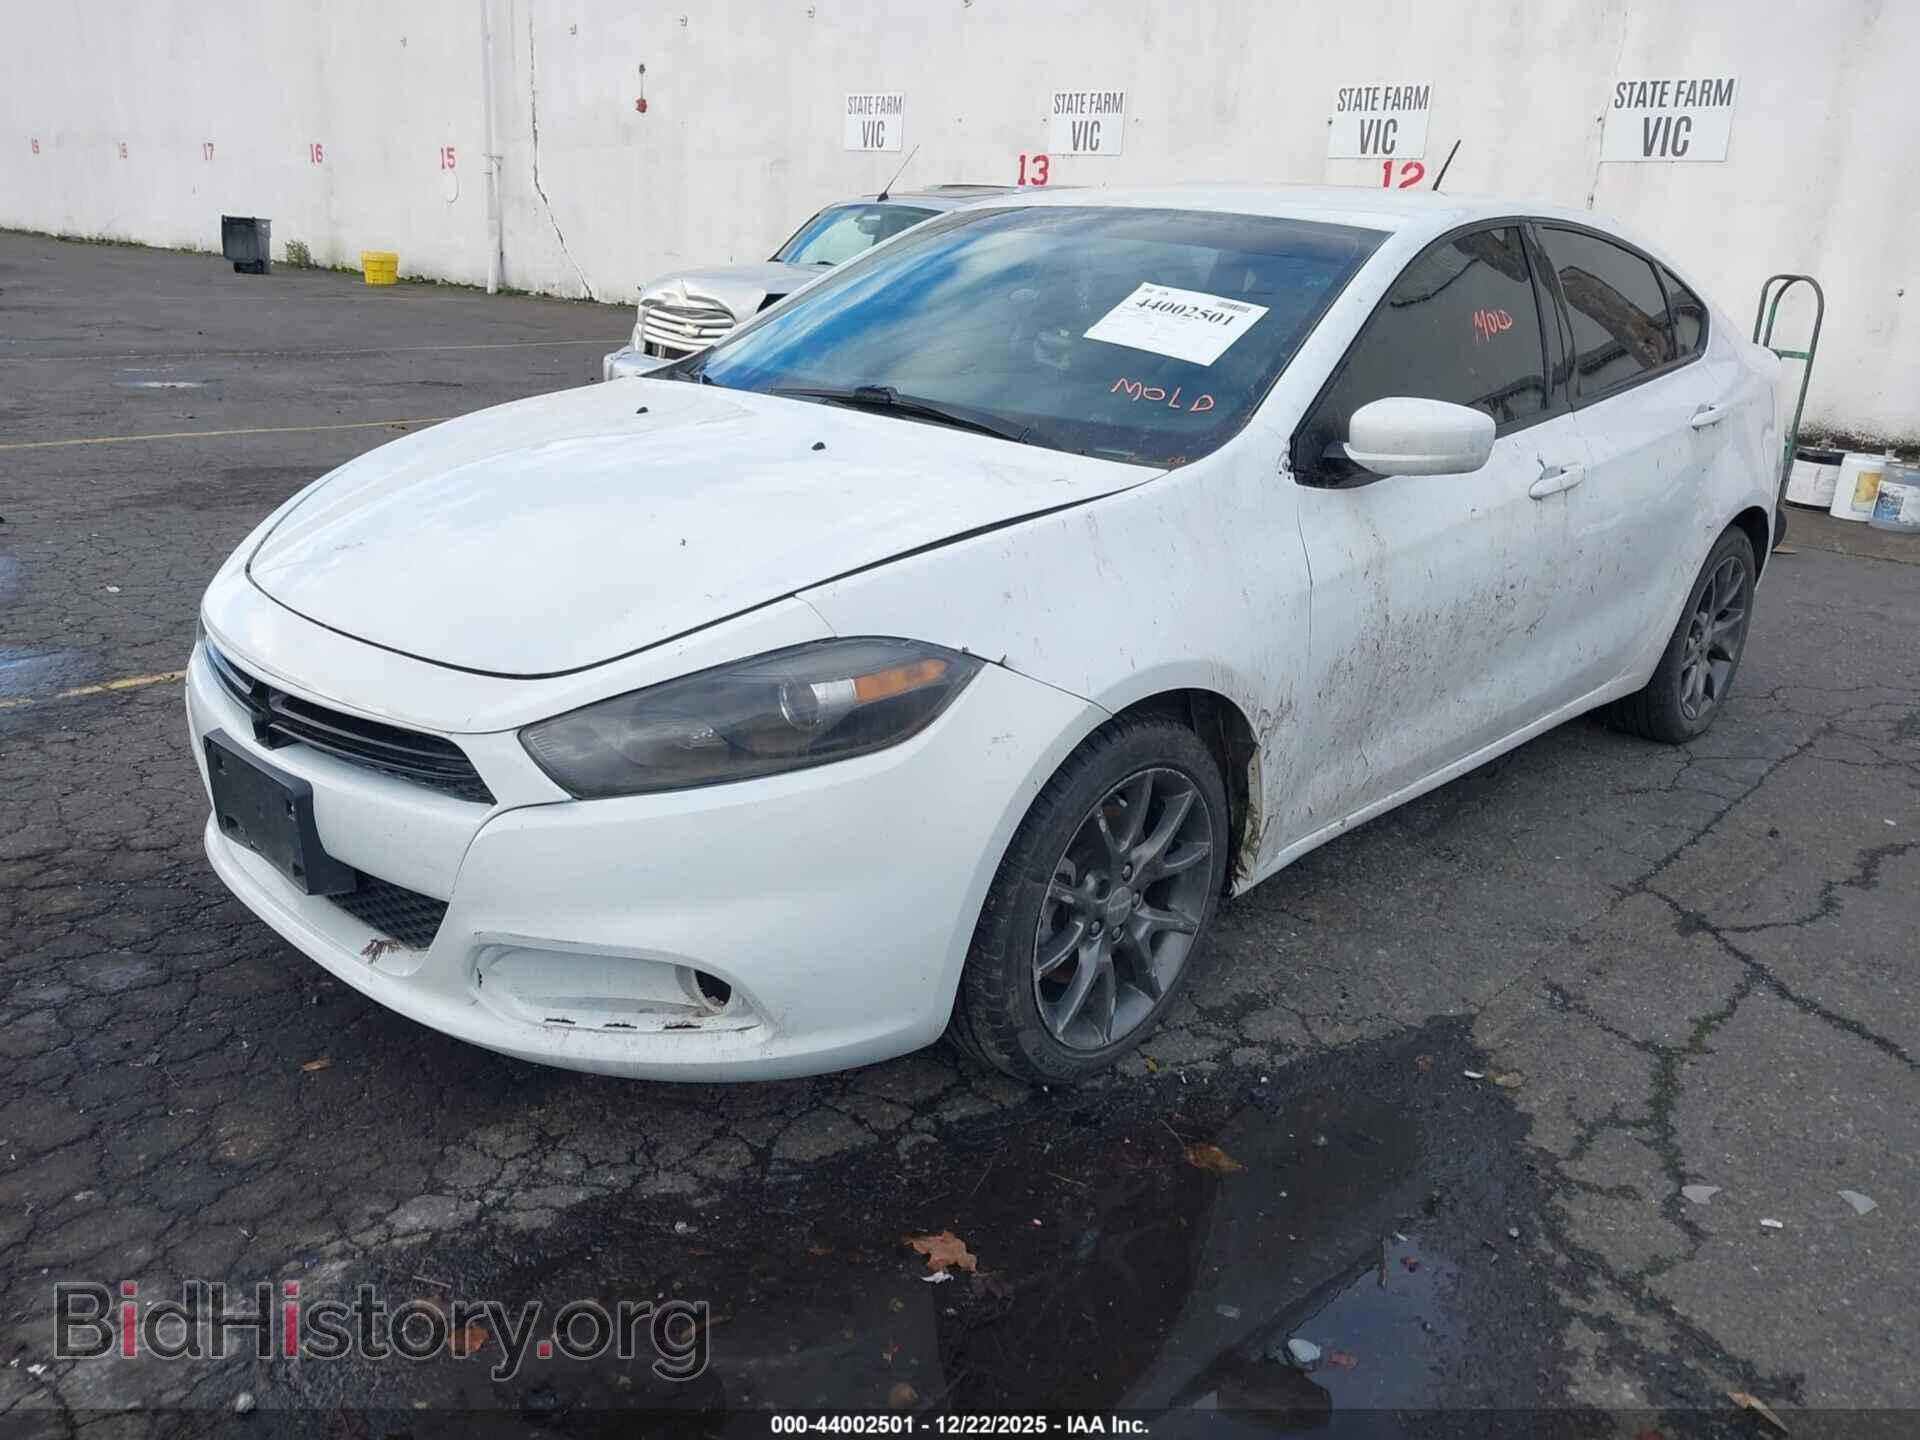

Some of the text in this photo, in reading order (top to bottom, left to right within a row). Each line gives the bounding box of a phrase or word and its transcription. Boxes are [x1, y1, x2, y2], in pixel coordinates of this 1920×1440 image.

[848, 95, 903, 115] STATE FARM
[1054, 92, 1124, 114] STATE FARM
[1337, 85, 1430, 112] STATE FARM
[1614, 78, 1735, 108] STATE FARM
[862, 120, 885, 148] VIC
[1072, 120, 1101, 152] VIC
[1359, 118, 1398, 155] VIC
[1641, 116, 1692, 157] VIC
[203, 143, 215, 160] 17
[310, 143, 324, 164] 16
[440, 146, 457, 169] 15
[1017, 154, 1050, 187] 13
[1382, 160, 1426, 188] 12
[1136, 298, 1236, 327] 44002501
[1473, 309, 1513, 341] MOLD
[1111, 378, 1215, 413] MOLD
